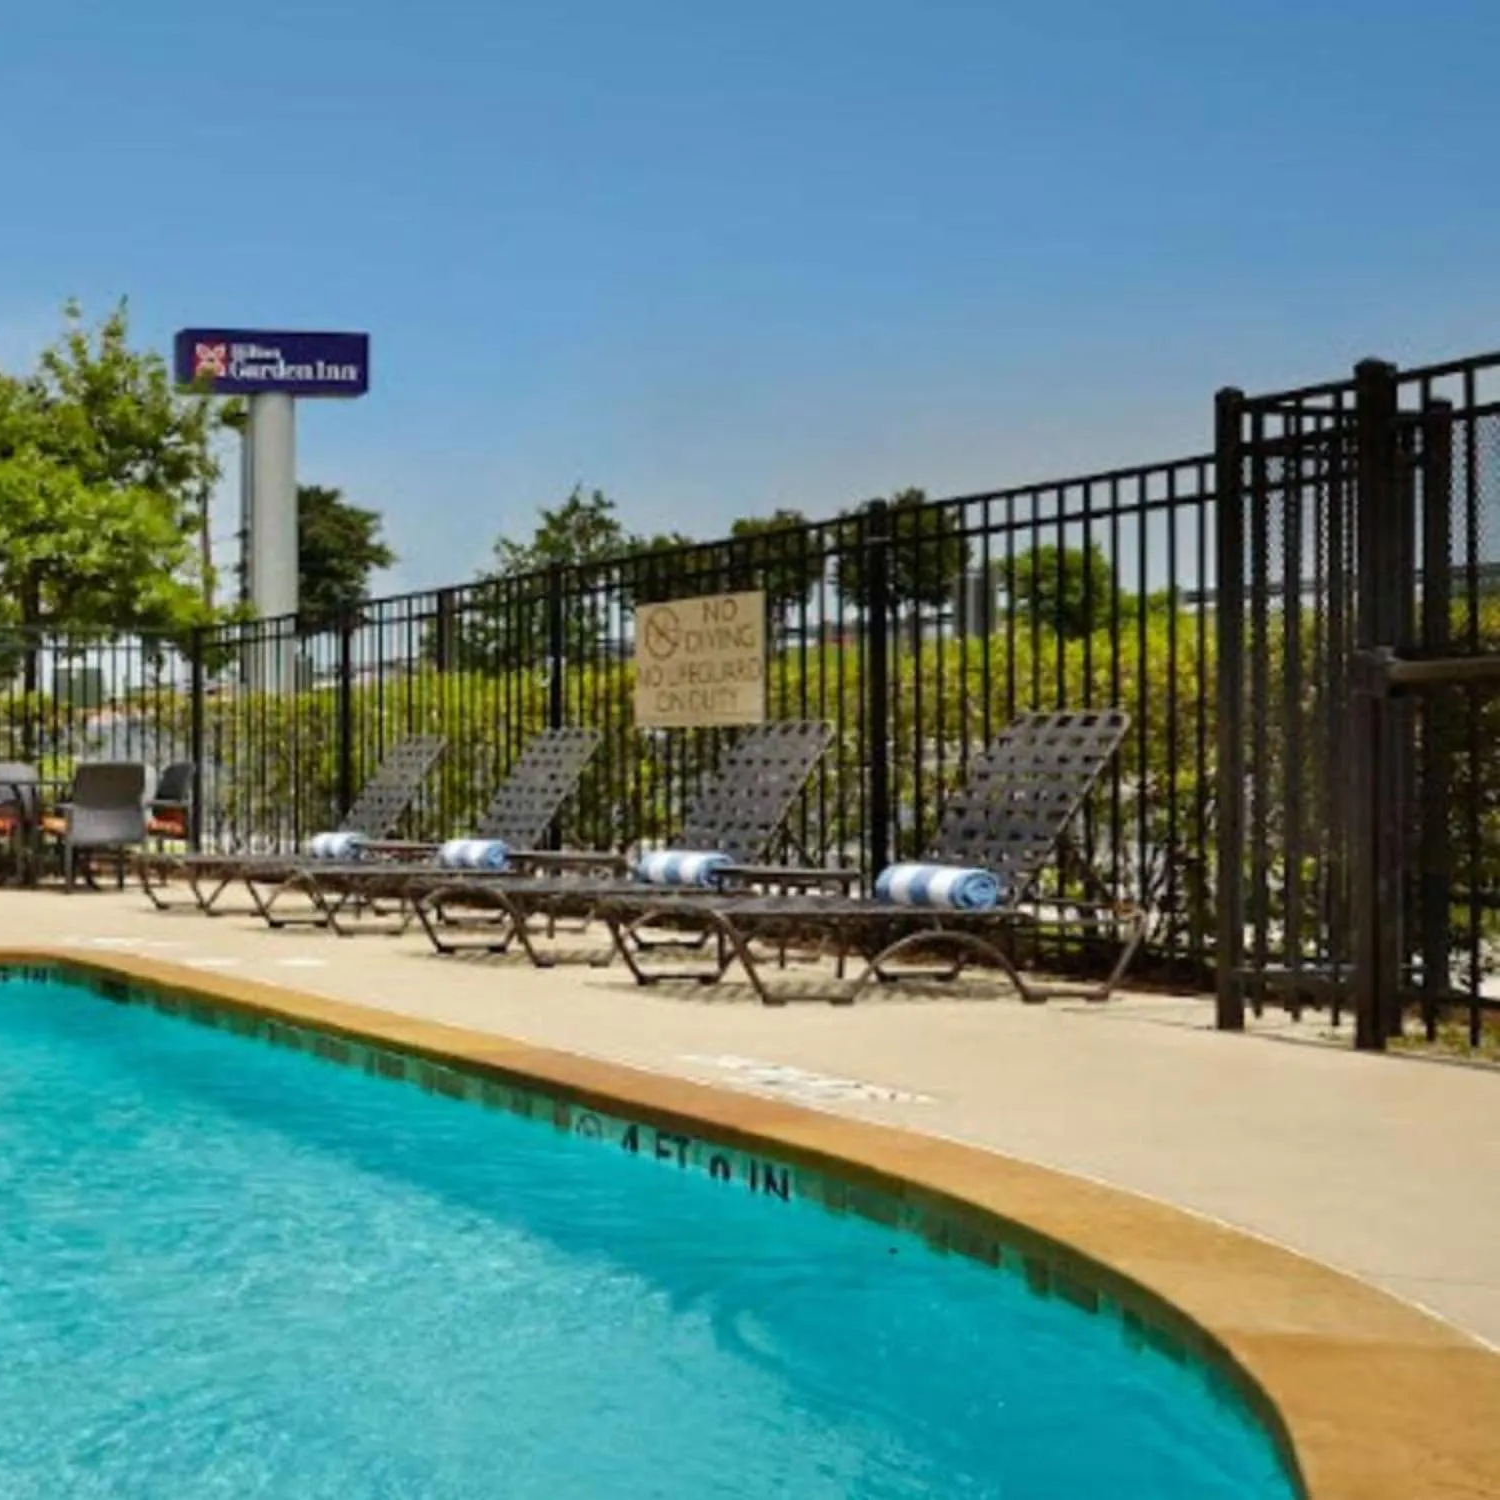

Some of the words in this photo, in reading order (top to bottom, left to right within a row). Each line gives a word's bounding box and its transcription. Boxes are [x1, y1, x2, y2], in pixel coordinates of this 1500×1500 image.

[229, 359, 314, 380] Garden
[316, 361, 357, 380] Inn
[702, 598, 738, 624] NO
[684, 623, 756, 652] DIVING
[642, 664, 664, 688] NO
[668, 657, 761, 687] LIFEGUARD
[655, 690, 685, 713] ON
[688, 686, 738, 713] DUTY
[621, 1123, 640, 1153] 4
[654, 1131, 691, 1169] FT
[750, 1158, 790, 1203] IN
